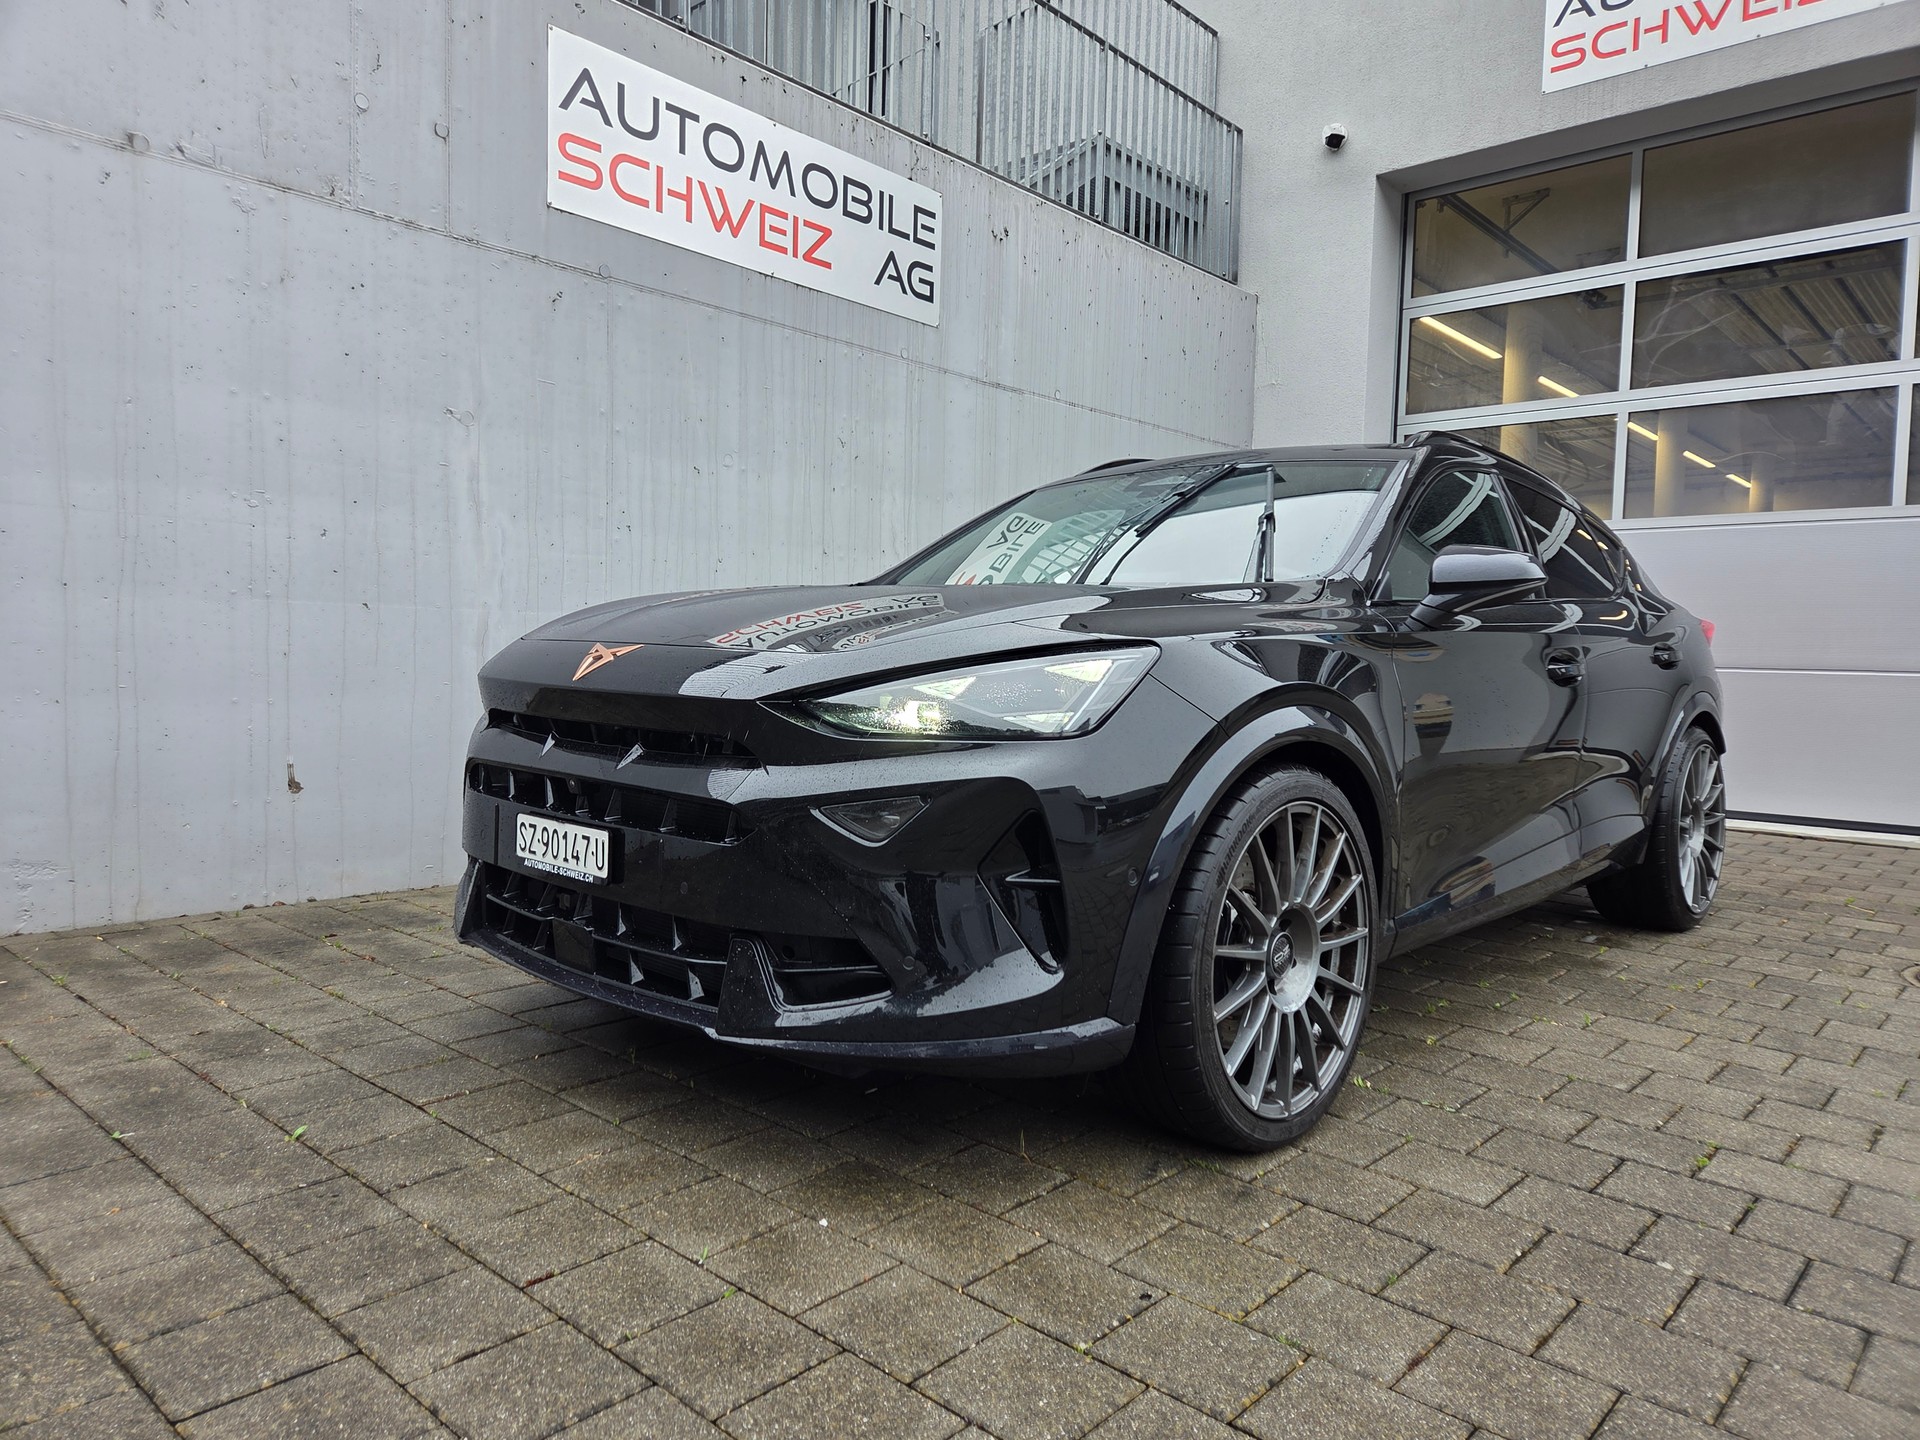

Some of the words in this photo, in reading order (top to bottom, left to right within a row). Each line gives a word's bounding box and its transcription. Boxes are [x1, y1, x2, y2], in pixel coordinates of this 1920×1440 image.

[557, 132, 833, 270] SCHWEIZ
[558, 67, 937, 251] AUTOMOBILE
[873, 250, 935, 304] AG
[523, 858, 594, 883] AUTOMOBILE-SCHWEIZ.CH
